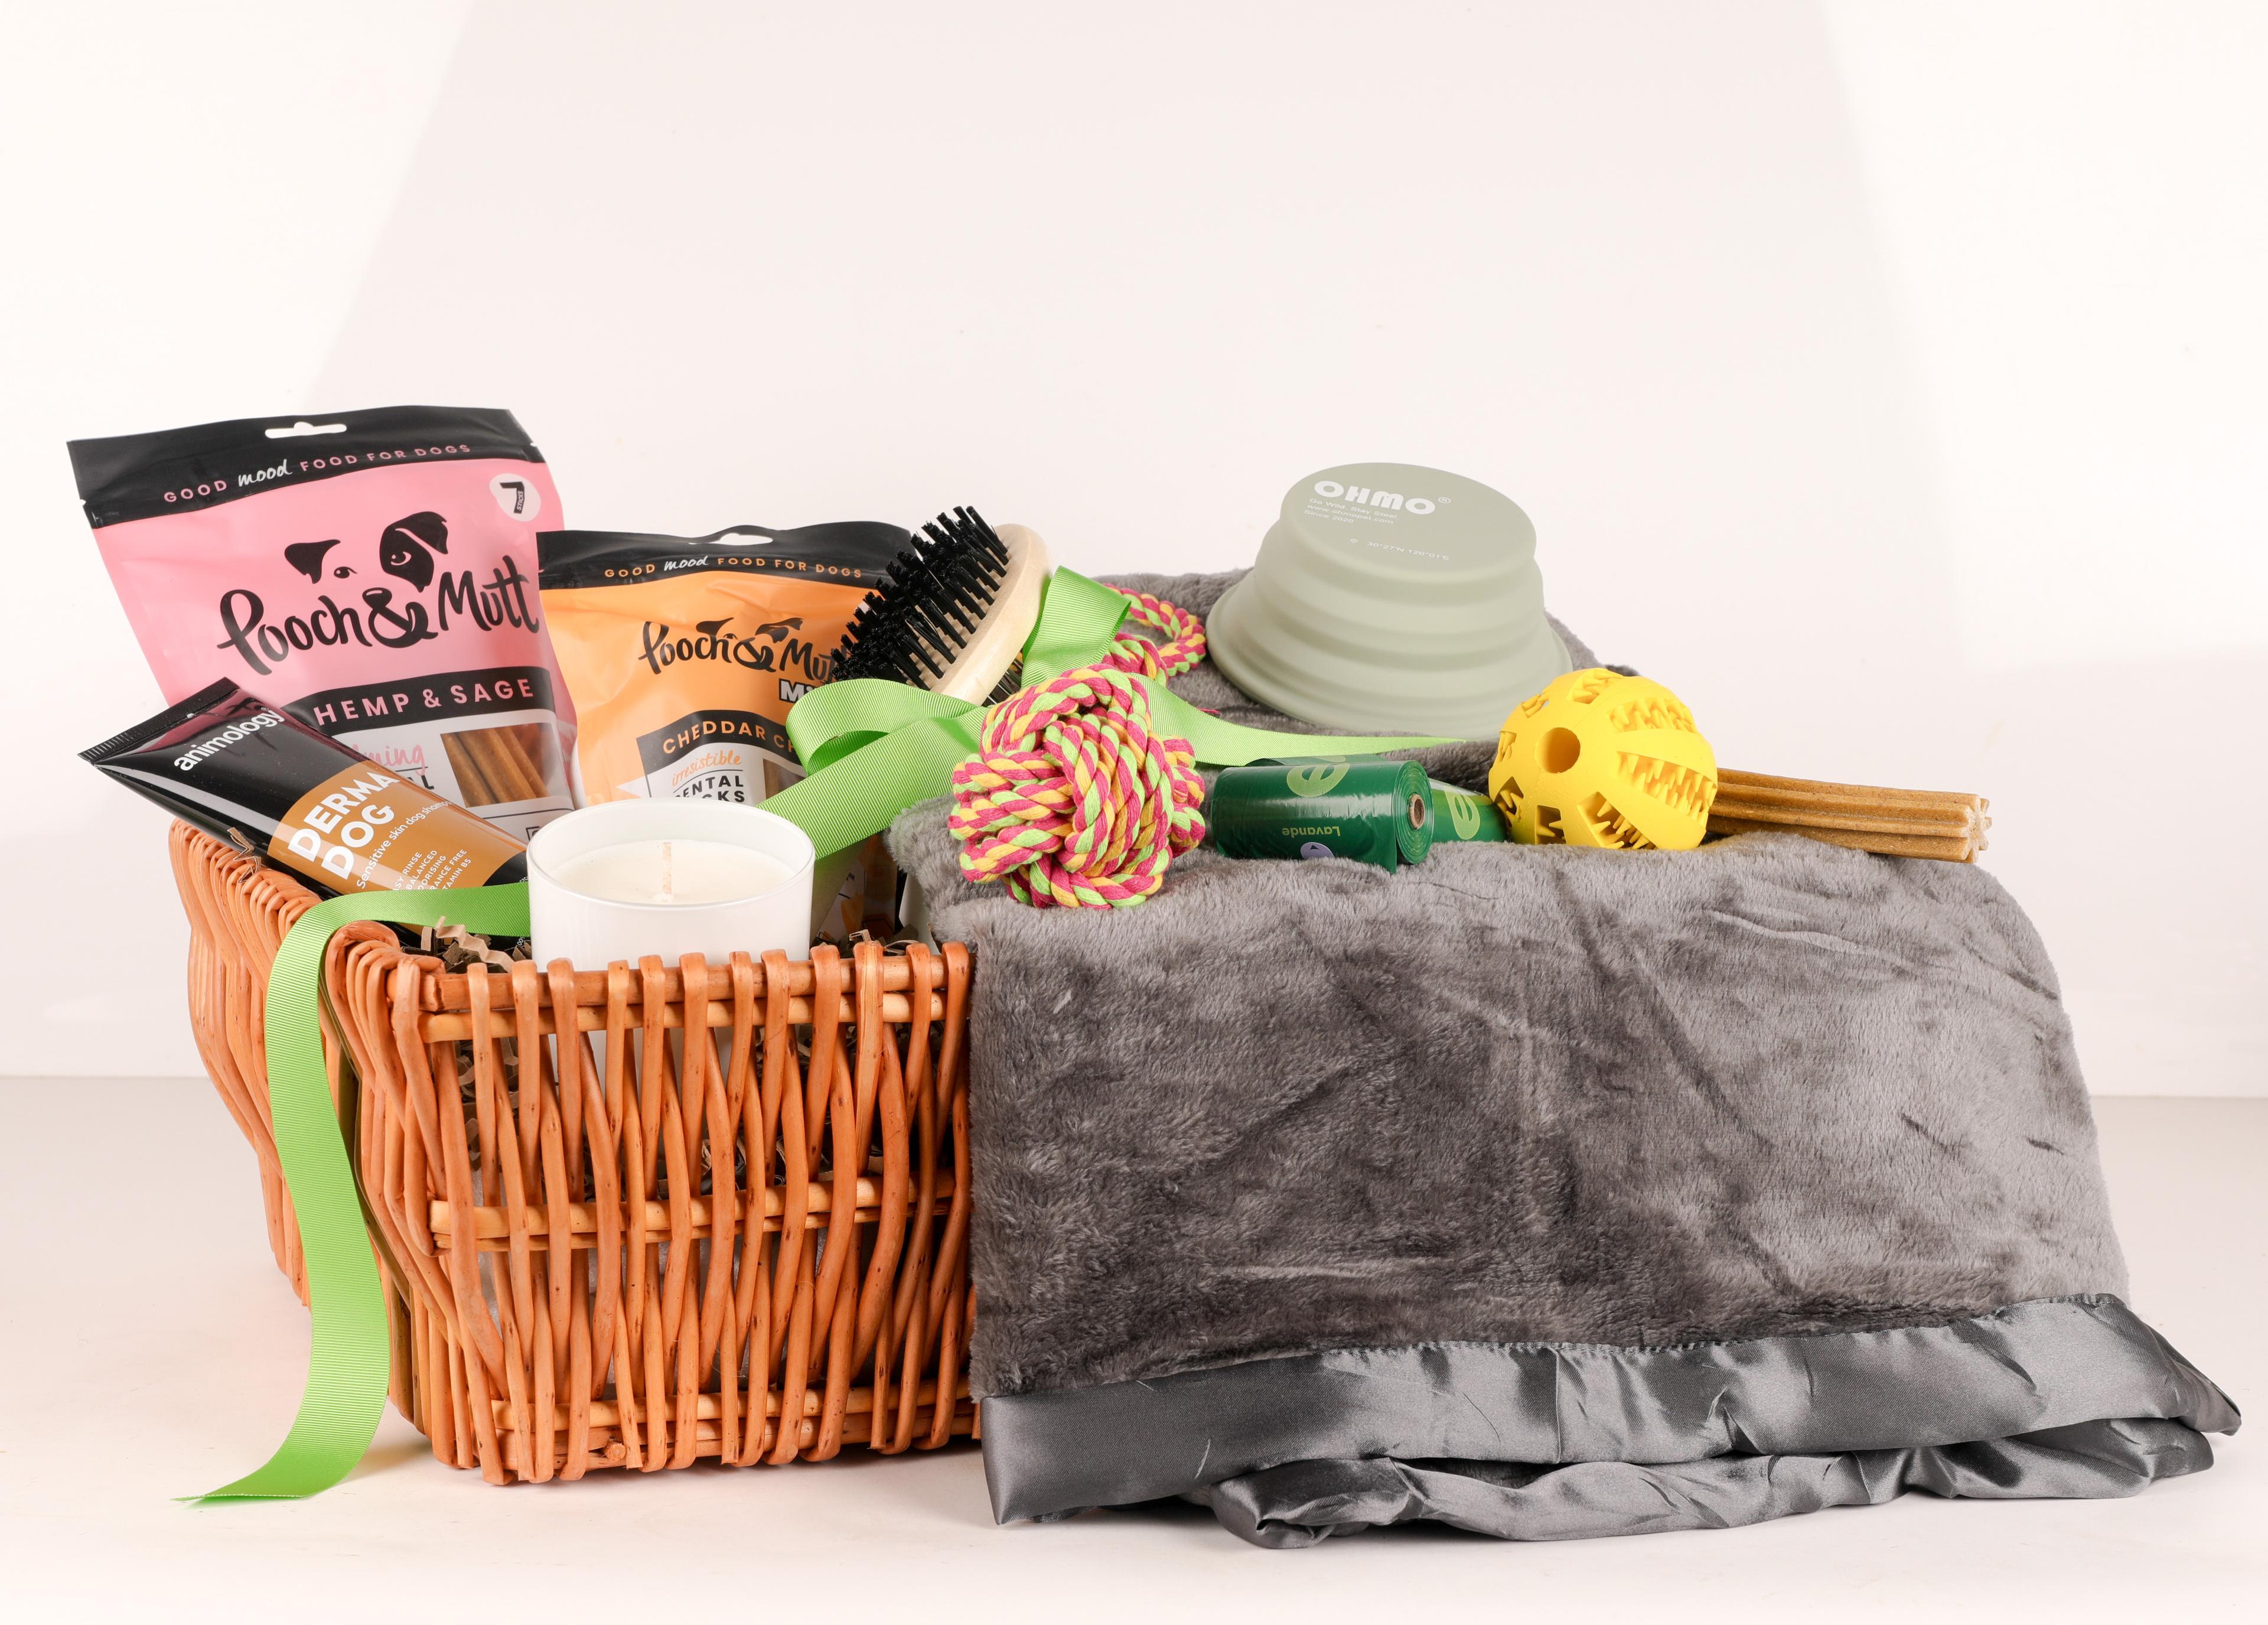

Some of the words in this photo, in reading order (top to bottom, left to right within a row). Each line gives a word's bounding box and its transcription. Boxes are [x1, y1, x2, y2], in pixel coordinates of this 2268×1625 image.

[164, 480, 227, 502] GOOD
[238, 459, 293, 487] mood
[299, 455, 357, 471] FOOD
[367, 450, 406, 461] FOR
[414, 445, 470, 457] DOGS
[499, 481, 524, 514] 7
[1304, 510, 1329, 519] Since
[1332, 515, 1354, 523] 2020
[1326, 501, 1347, 510] Wild.
[1351, 506, 1371, 514] Stay
[1374, 511, 1399, 519] Steel.
[605, 564, 656, 577] GOOD
[664, 555, 709, 571] mood
[718, 558, 765, 566] FOOD
[774, 559, 807, 571] FOR
[816, 564, 862, 578] DOGS
[217, 589, 373, 676] Pooch
[438, 555, 540, 633] Mutt
[638, 621, 733, 675] Pooch
[779, 638, 847, 681] Mut
[313, 693, 409, 726] HEMP
[422, 688, 442, 708] &
[449, 678, 535, 705] SAGE
[174, 709, 285, 771] animology
[663, 720, 766, 754] CHEDDAR
[672, 750, 742, 787] irresistible
[675, 775, 745, 797] ENTAL
[288, 772, 401, 862] DERMA
[1282, 826, 1341, 838] Lavande
[321, 805, 395, 880] DOG
[357, 840, 392, 889] Sensitive
[389, 823, 409, 841] skin
[406, 812, 426, 826] dog
[393, 876, 405, 890] SY
[402, 852, 423, 875] RINSE
[406, 851, 438, 890] BALANCED
[417, 855, 447, 890] DORISING
[429, 865, 452, 890] RANCE
[449, 849, 467, 865] FREE
[442, 868, 463, 890] TAMIN
[461, 858, 472, 868] B5
